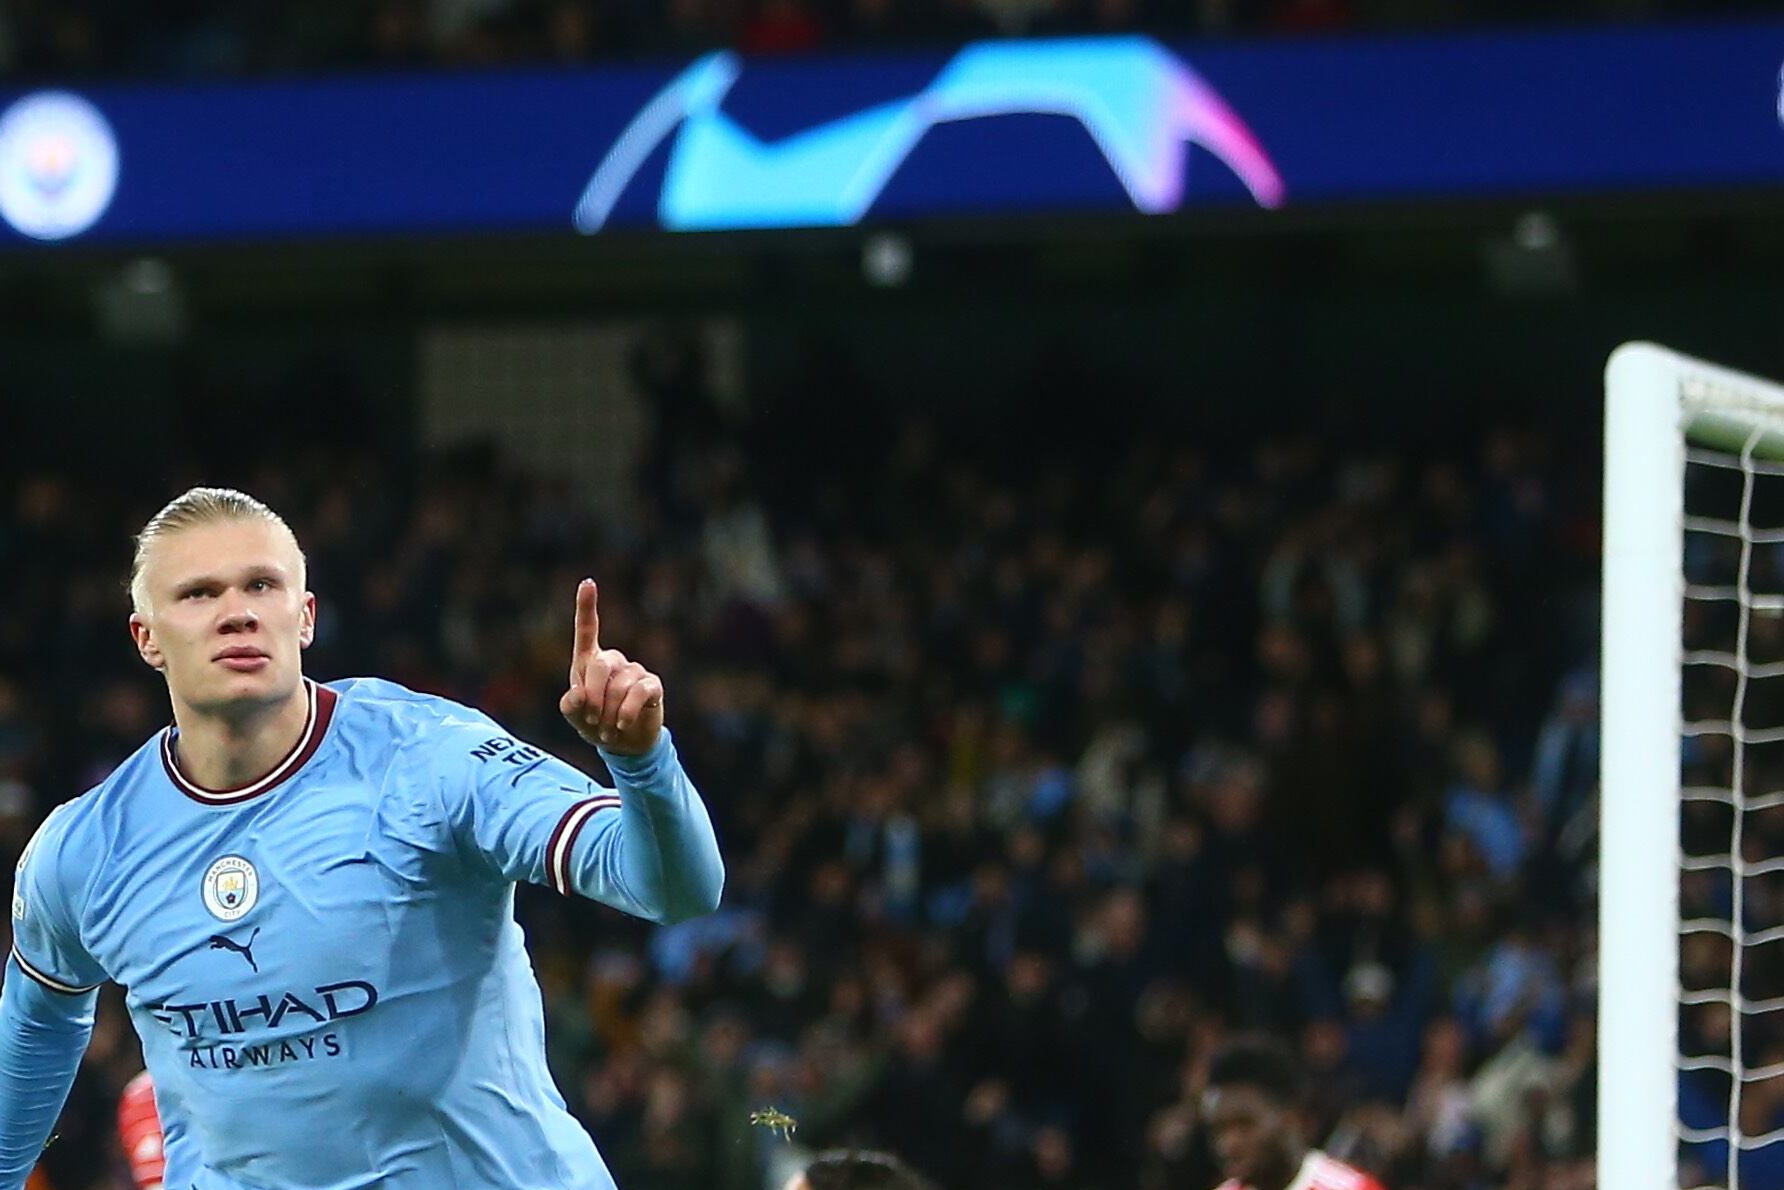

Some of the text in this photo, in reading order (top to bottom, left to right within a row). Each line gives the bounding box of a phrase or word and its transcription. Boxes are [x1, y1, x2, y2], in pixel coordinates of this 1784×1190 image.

[208, 860, 253, 882] MANCHESTER
[224, 910, 241, 918] CITY
[190, 1034, 341, 1069] AIRWAYS
